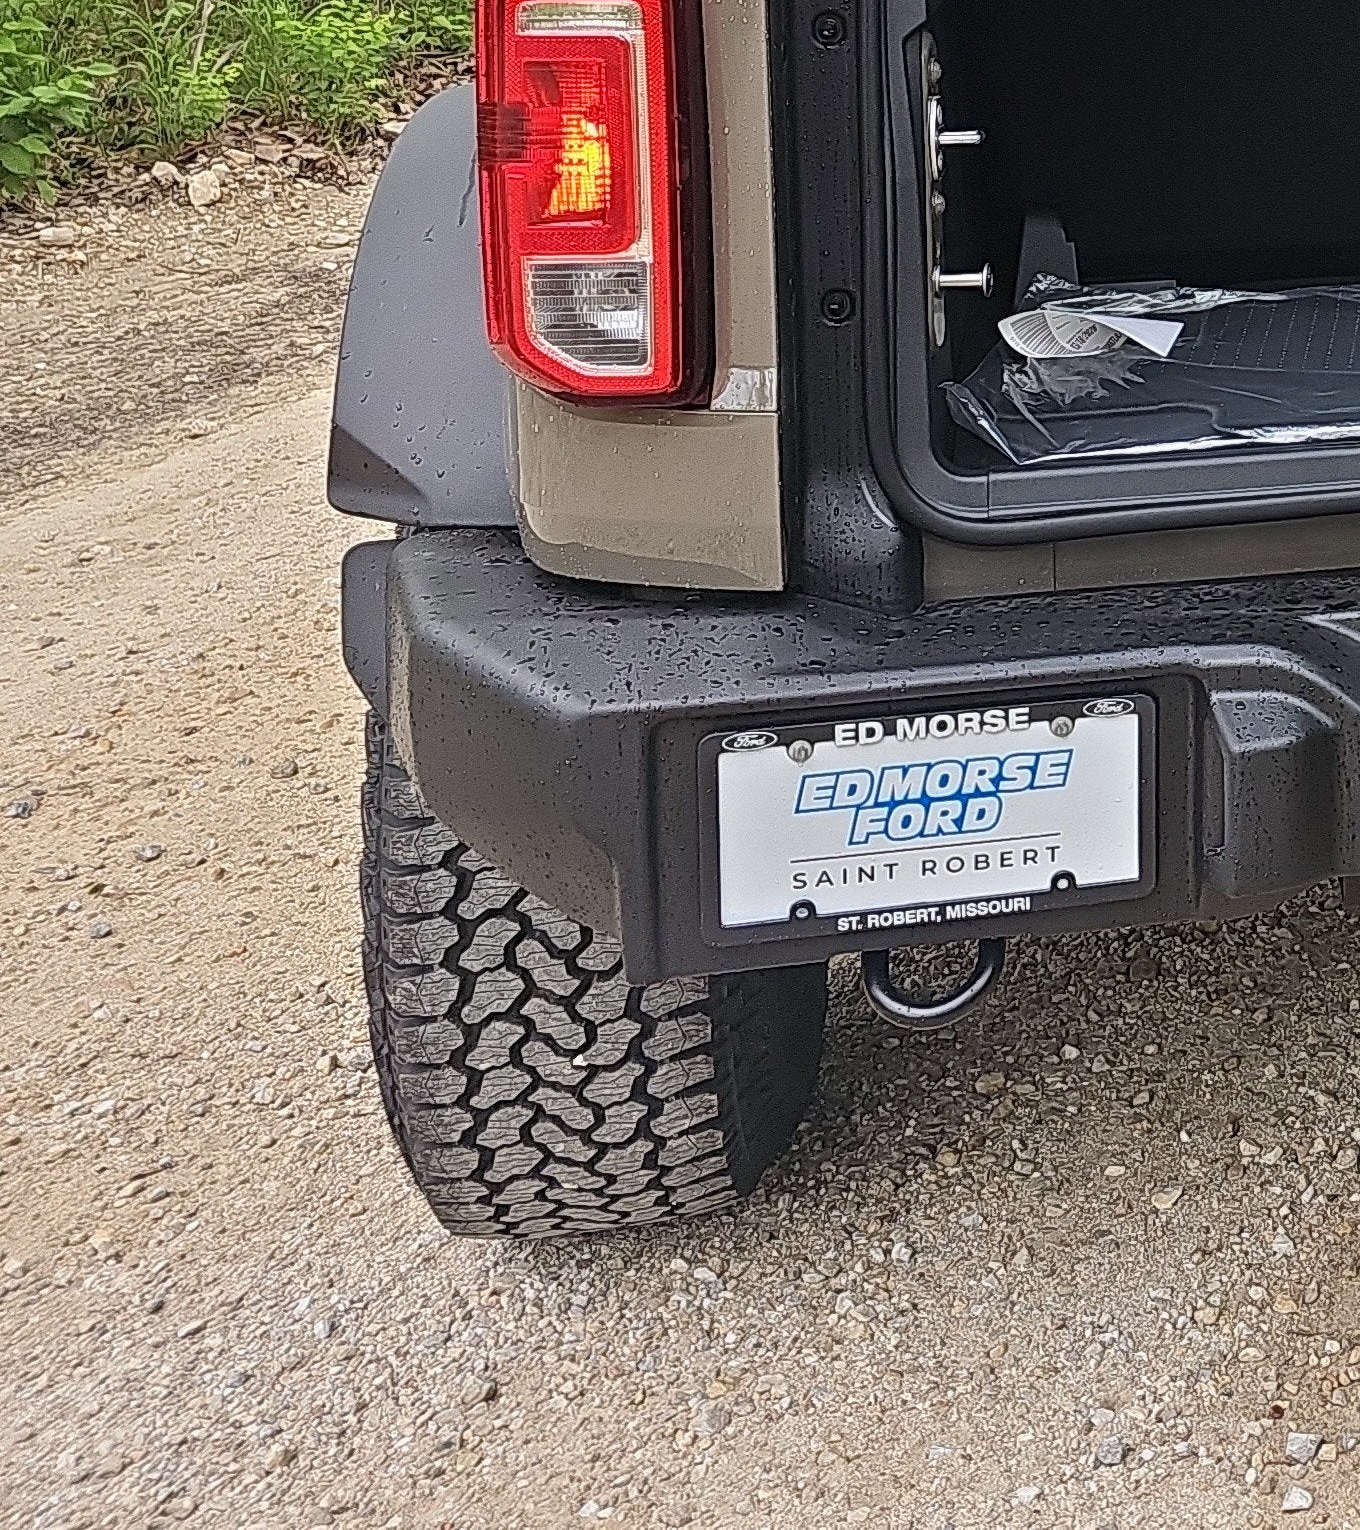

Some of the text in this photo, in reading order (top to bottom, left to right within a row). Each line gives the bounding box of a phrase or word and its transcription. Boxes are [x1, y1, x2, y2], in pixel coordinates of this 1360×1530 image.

[834, 707, 1030, 746] ED MORSE
[795, 749, 1074, 814] ED MORSE
[848, 795, 1003, 845] FORD
[792, 845, 1061, 890] SAINT ROBERT
[837, 896, 1032, 932] ST. ROBERT, MISSOURI
